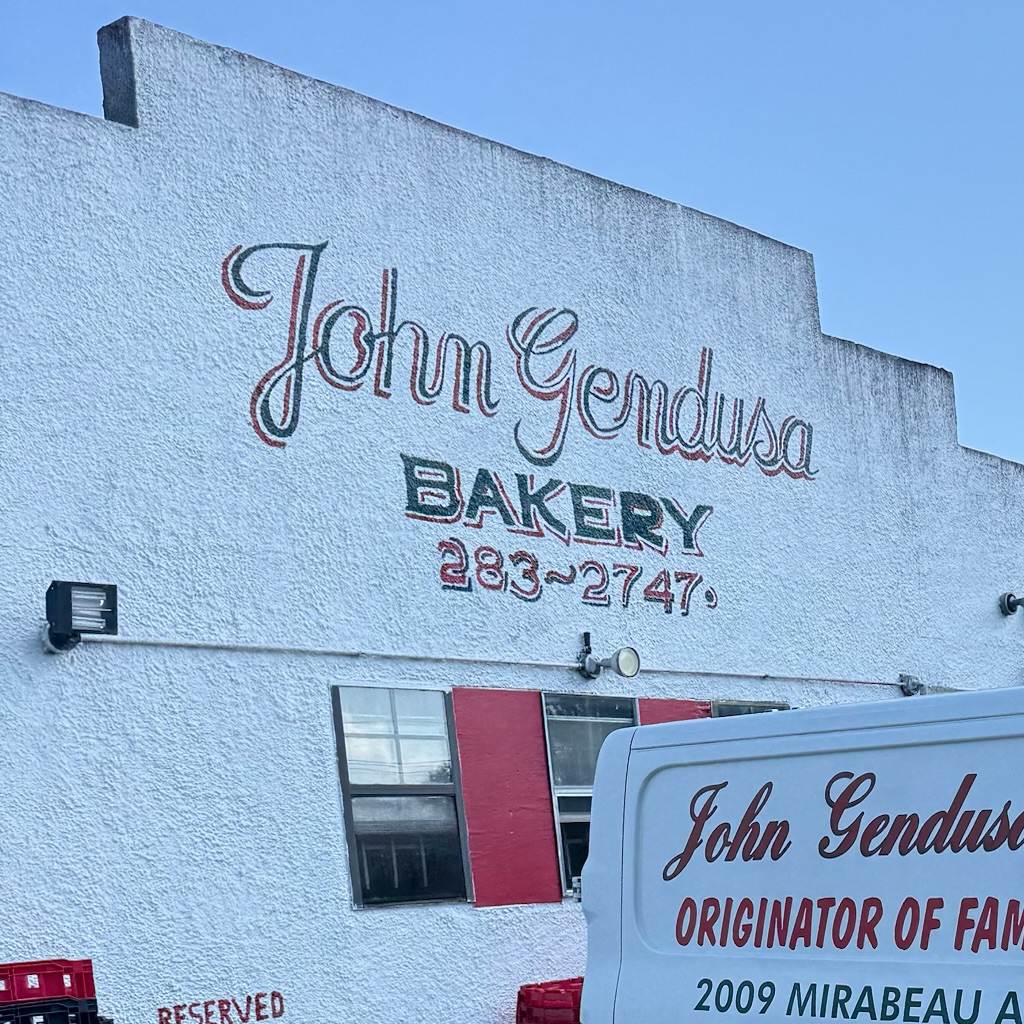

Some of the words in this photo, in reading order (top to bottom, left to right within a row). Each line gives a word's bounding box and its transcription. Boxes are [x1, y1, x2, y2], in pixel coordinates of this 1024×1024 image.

[222, 240, 498, 449] John
[506, 307, 819, 481] Gendusa
[400, 453, 713, 557] BAKERY
[662, 780, 792, 882] John
[675, 896, 884, 951] ORIGINATOR
[894, 896, 944, 951] OF
[693, 978, 776, 1015] 2009
